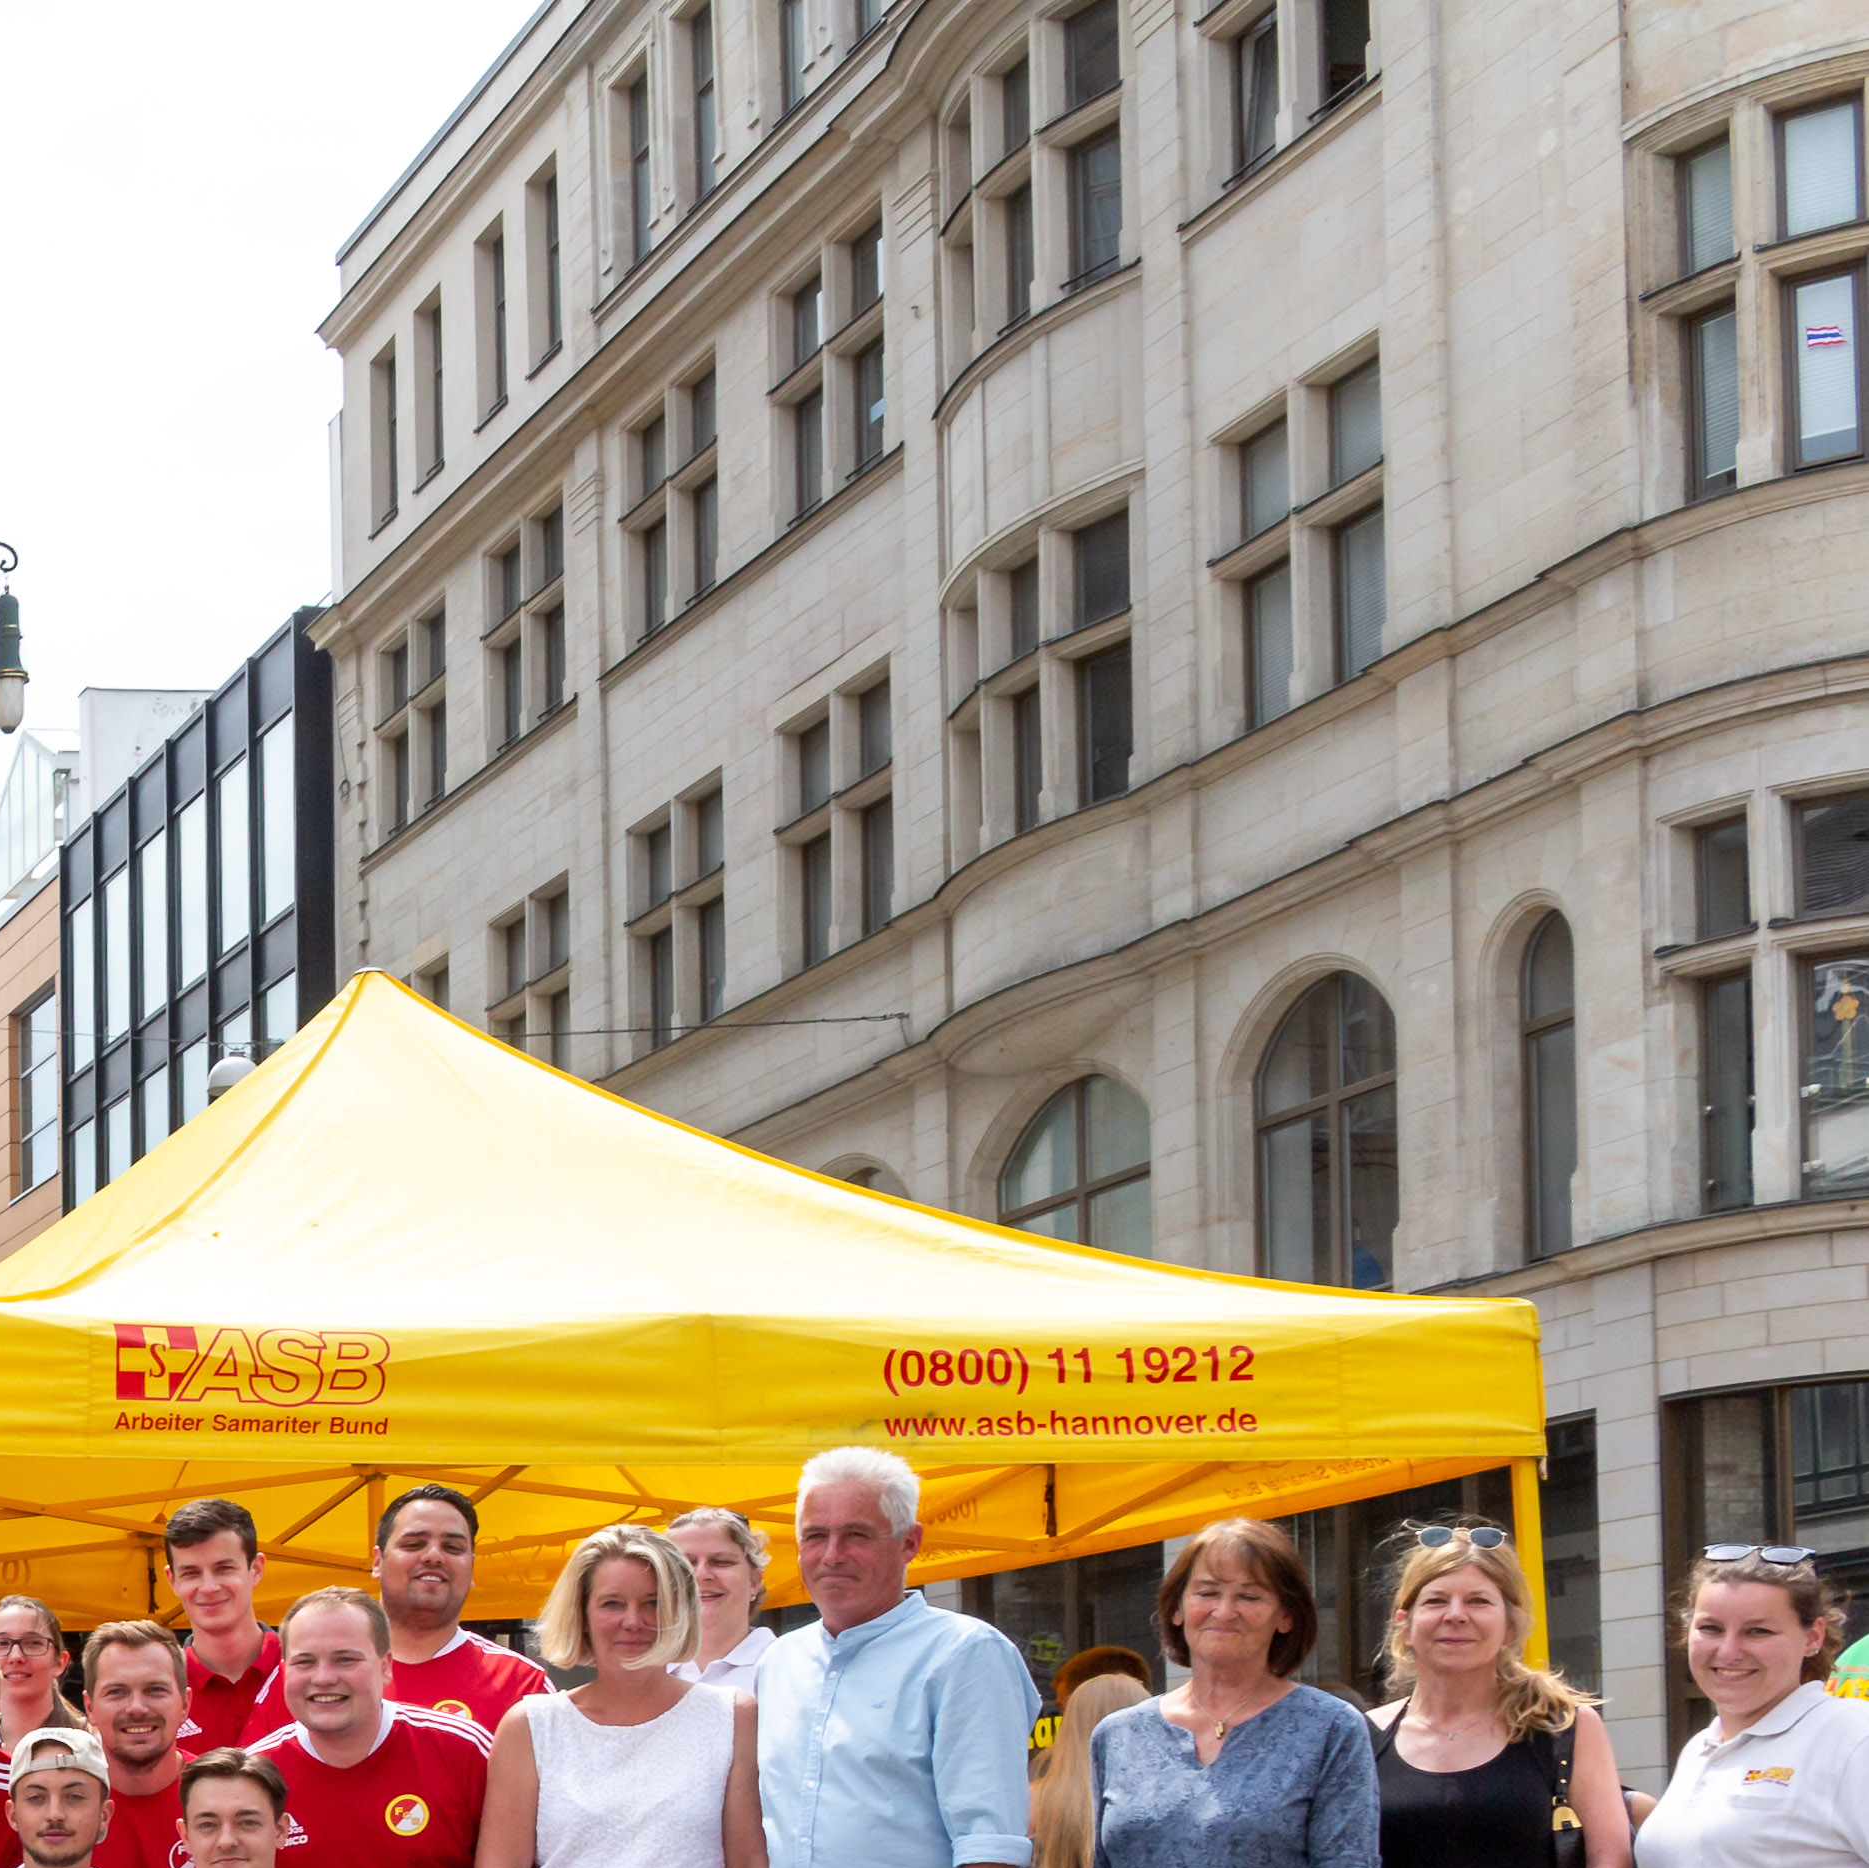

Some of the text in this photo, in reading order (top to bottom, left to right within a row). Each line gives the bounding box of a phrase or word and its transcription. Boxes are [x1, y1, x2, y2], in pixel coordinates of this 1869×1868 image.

[177, 1328, 391, 1408] ASB
[883, 1345, 1255, 1397] (0800) 11 19212
[114, 1411, 389, 1437] Arbeiter Samariter Bund
[884, 1407, 1259, 1439] www.asb-hannover.de
